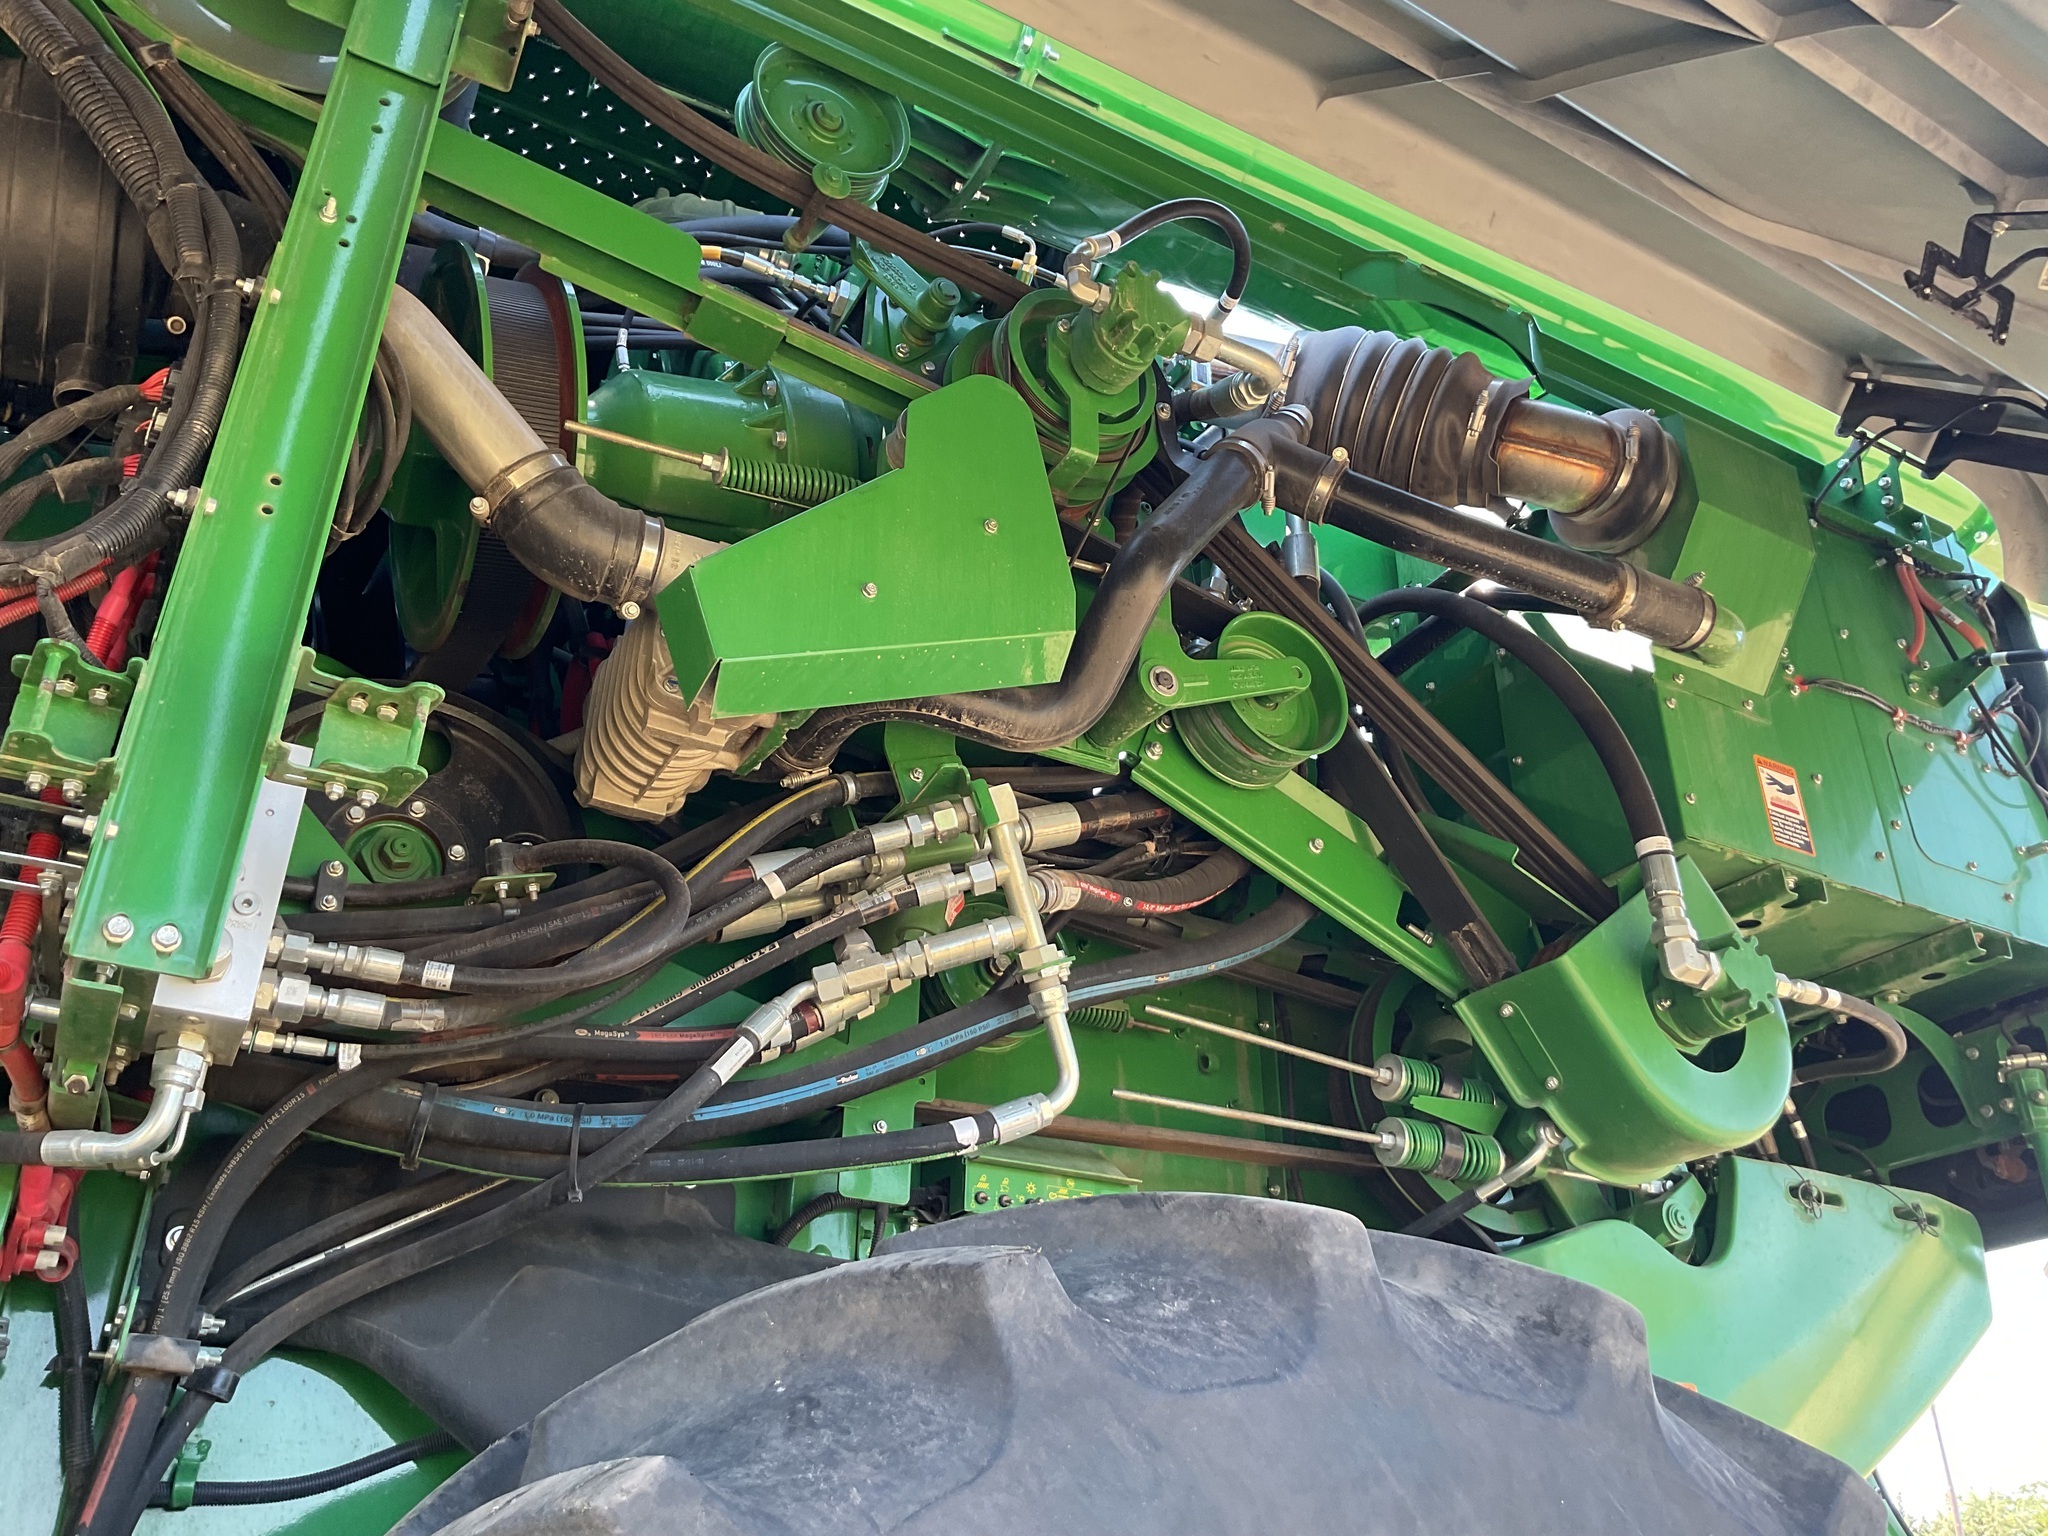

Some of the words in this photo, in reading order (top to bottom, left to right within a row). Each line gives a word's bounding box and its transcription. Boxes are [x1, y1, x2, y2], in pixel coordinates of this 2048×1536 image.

[1762, 760, 1794, 776] WARNING
[548, 919, 562, 928] SAE
[318, 1072, 338, 1086] Flame
[279, 1091, 306, 1115] 100R15
[266, 1112, 281, 1125] SAE
[537, 1112, 555, 1121] MPa
[251, 1127, 266, 1140] 4SH
[240, 1138, 254, 1153] R15
[224, 1152, 243, 1174] EN856
[207, 1174, 227, 1201] Exceeds
[196, 1203, 208, 1218] 4SH
[189, 1218, 201, 1234] R15
[180, 1234, 194, 1253] 3862
[176, 1252, 185, 1265] ISO
